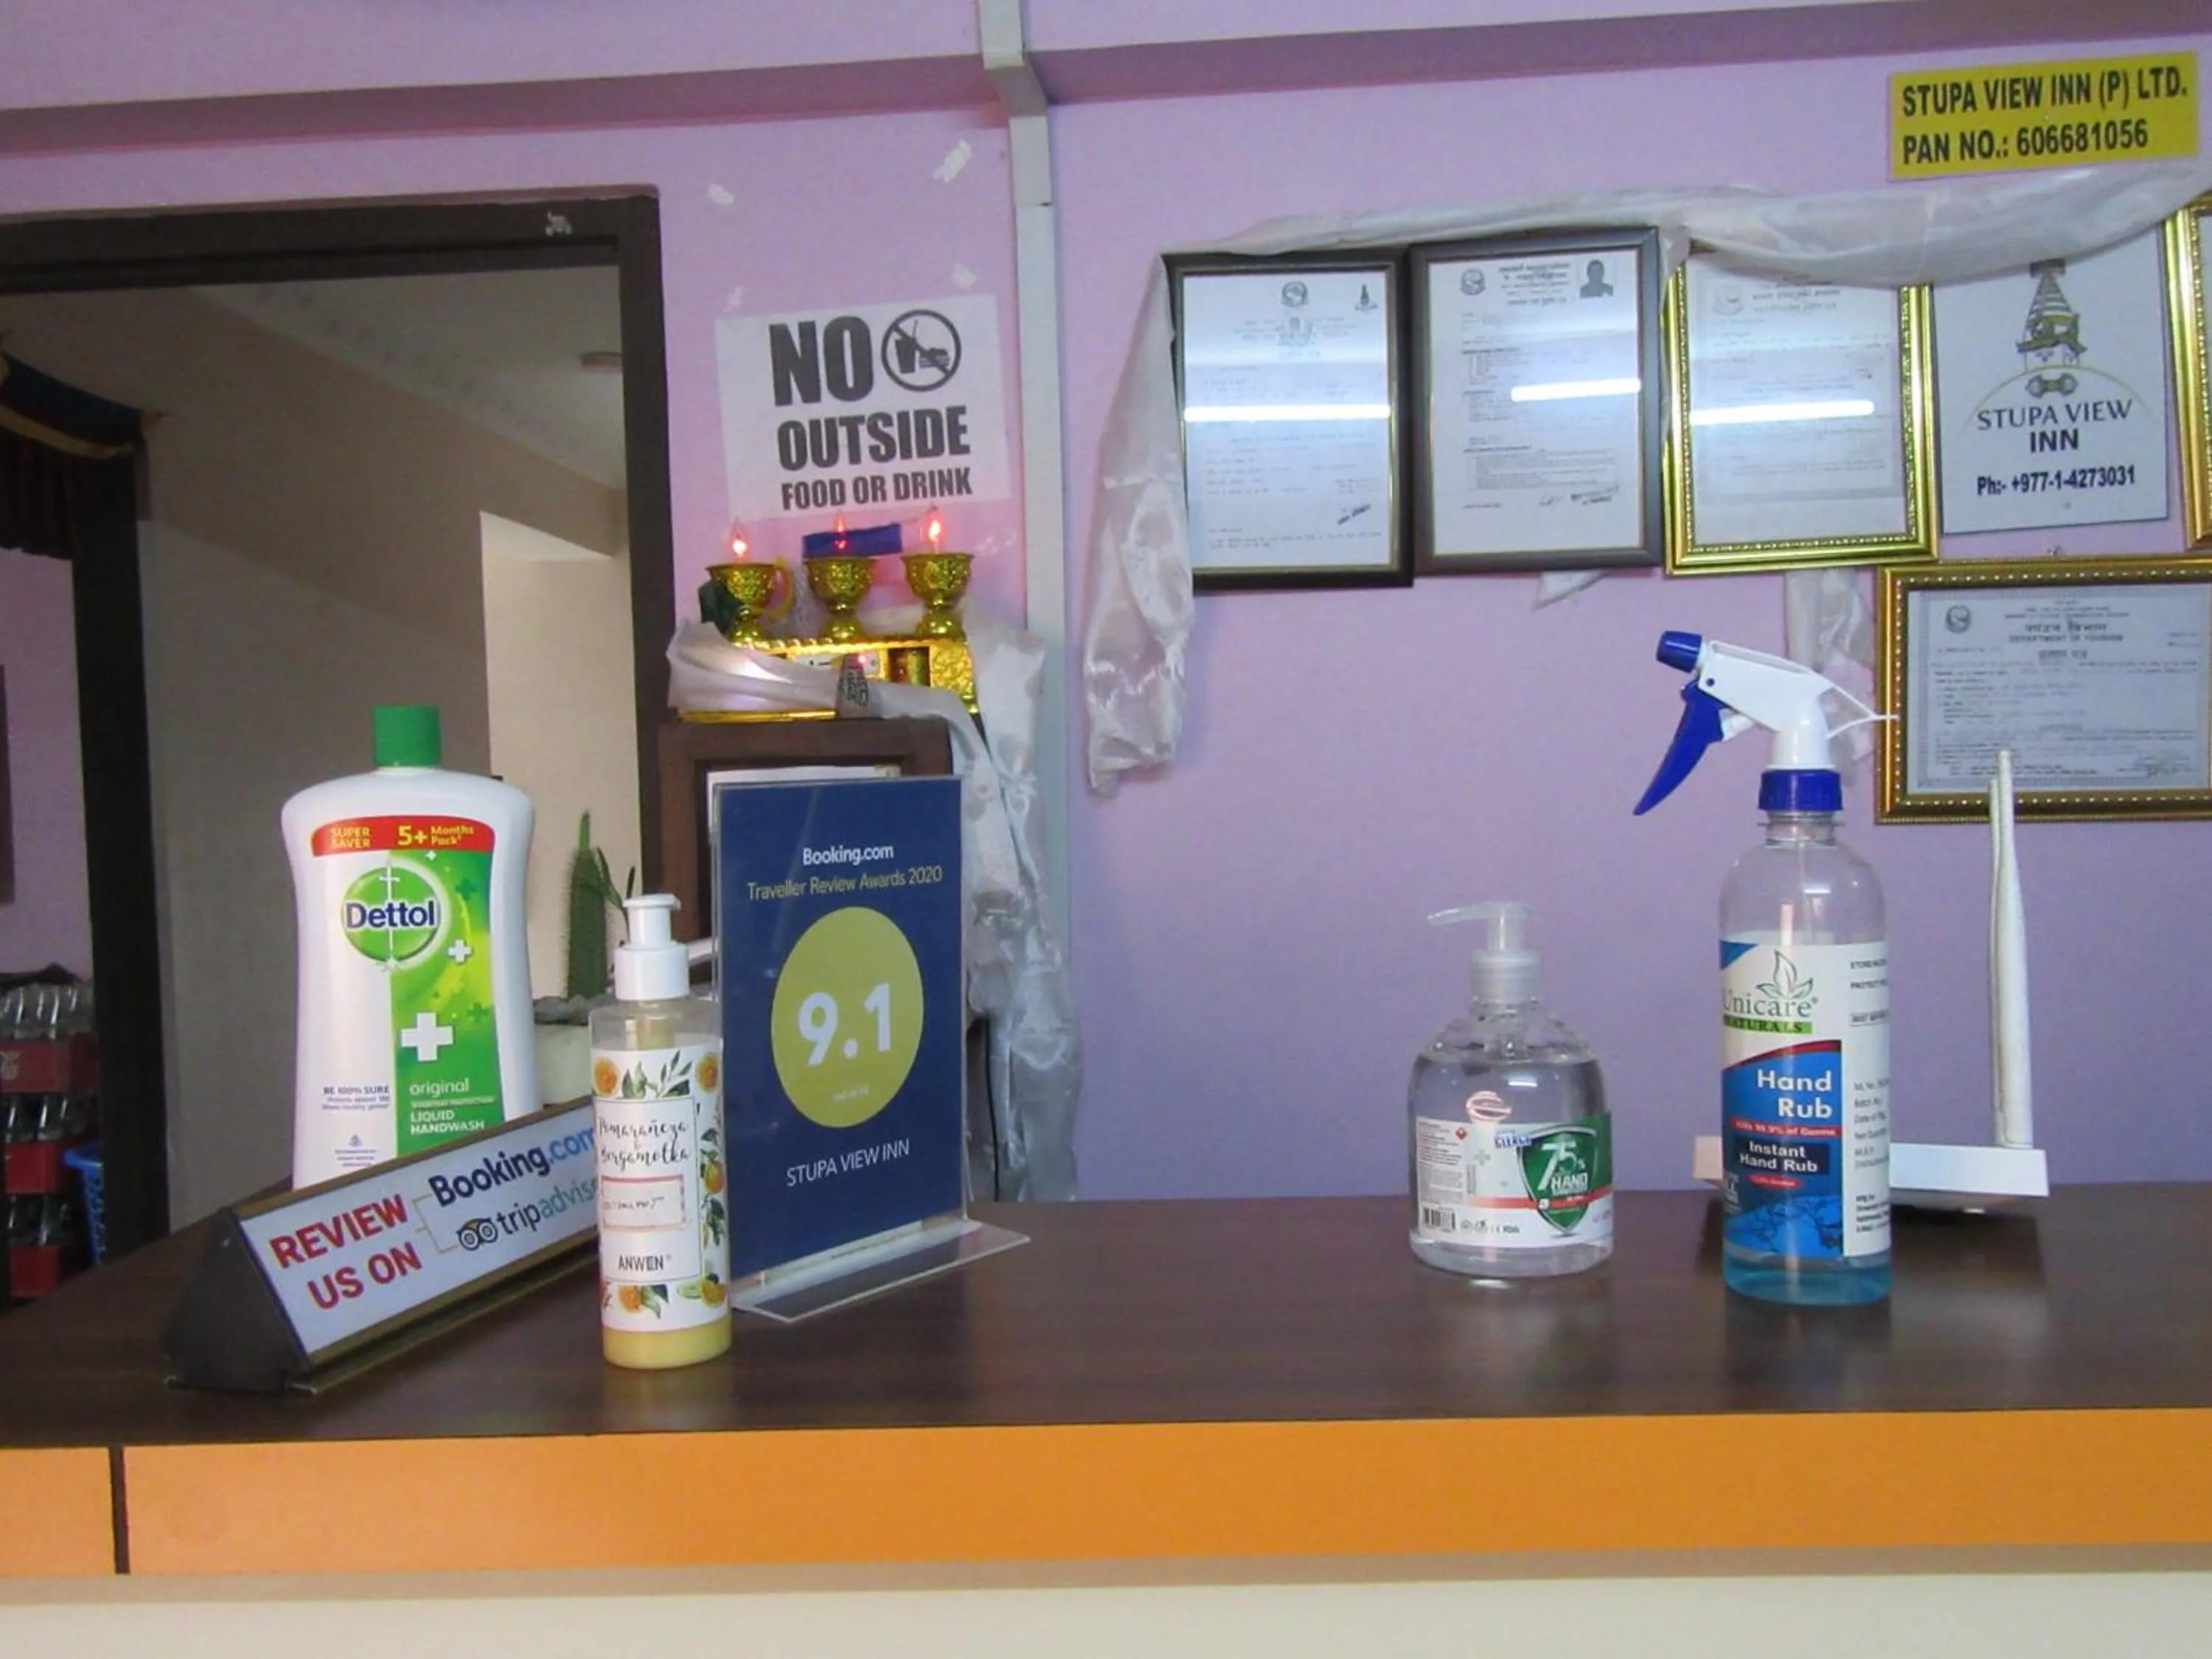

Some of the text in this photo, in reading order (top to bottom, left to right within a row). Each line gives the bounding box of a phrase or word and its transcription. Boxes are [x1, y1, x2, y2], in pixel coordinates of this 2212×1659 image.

[1902, 66, 2188, 117] STUPA VIEW INN (P) LTD.
[1902, 119, 2148, 164] PAN NO.: 606681056
[769, 316, 874, 406] NO
[1977, 399, 2133, 431] STUPA VIEW
[777, 406, 971, 471] OUTSIDE
[2030, 428, 2079, 453] INN
[782, 467, 973, 510] FOOD OR DRINK
[2011, 464, 2135, 493] +977-1-4273031
[331, 824, 474, 846] SUPER 5+ Months
[331, 838, 370, 848] SAVER
[802, 844, 894, 866] Booking.com
[747, 865, 942, 900] Traveller Review Awards 2020
[345, 900, 435, 928] Dettol
[797, 982, 892, 1067] 9.1
[364, 1085, 390, 1094] SURE
[409, 1079, 470, 1098] original
[1757, 1068, 1832, 1092] Hand
[411, 1110, 455, 1122] LIQUID
[1778, 1096, 1833, 1119] Rub
[411, 1121, 484, 1134] HANDWASH
[787, 1138, 910, 1187] STUPA VIEW INN
[1739, 1153, 1818, 1172] Hand Rub
[1749, 1141, 1806, 1158] Instant
[428, 1127, 594, 1207] Booking.com
[269, 1194, 408, 1269] REVIEW
[307, 1242, 422, 1311] US ON
[618, 1255, 664, 1272] ANWEN
